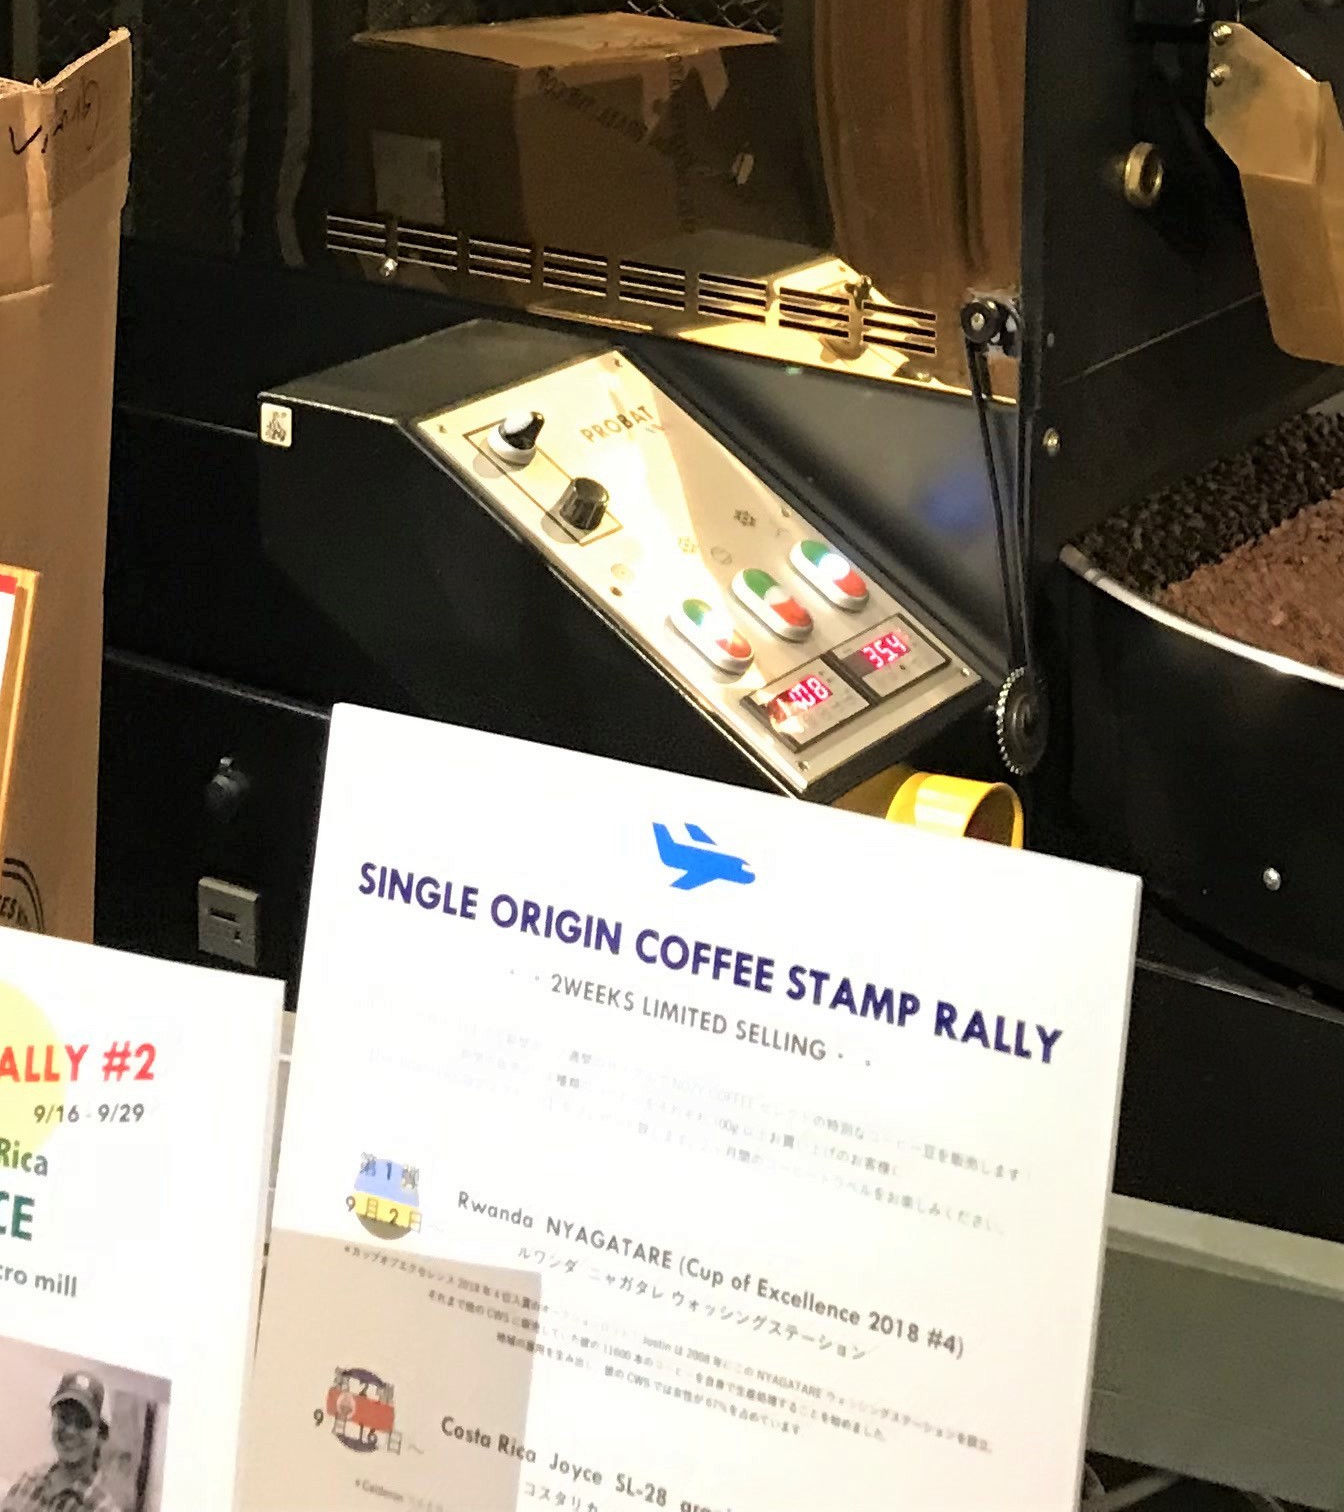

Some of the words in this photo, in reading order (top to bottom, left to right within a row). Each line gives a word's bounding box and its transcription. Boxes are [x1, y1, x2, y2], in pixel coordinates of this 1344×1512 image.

[580, 405, 654, 443] PROBAT
[358, 861, 479, 921] SINGLE
[490, 893, 623, 955] ORIGIN
[635, 928, 775, 993] COFFEE
[785, 965, 920, 1028] STAMP
[934, 1000, 1062, 1065] RALLY
[550, 973, 635, 1013] 2WEEKS
[642, 996, 728, 1035] LIMITED
[735, 1019, 827, 1061] SELLING
[102, 1040, 157, 1083] #2
[33, 1104, 80, 1125] 9/16
[97, 1103, 146, 1125] 9/29
[458, 1190, 533, 1229] Rwanda
[546, 1215, 672, 1271] NYAGATARE
[680, 1254, 724, 1289] (Cup
[731, 1272, 752, 1292] of
[756, 1277, 861, 1326] Excellence
[869, 1310, 920, 1344] 2018
[926, 1326, 964, 1360] #4)
[517, 1245, 579, 1275] ルワンダ
[34, 1272, 77, 1298] mill
[440, 1415, 491, 1449] Costa
[497, 1433, 536, 1464] Rica
[549, 1452, 603, 1487] Joyce
[614, 1472, 667, 1507] SL-28
